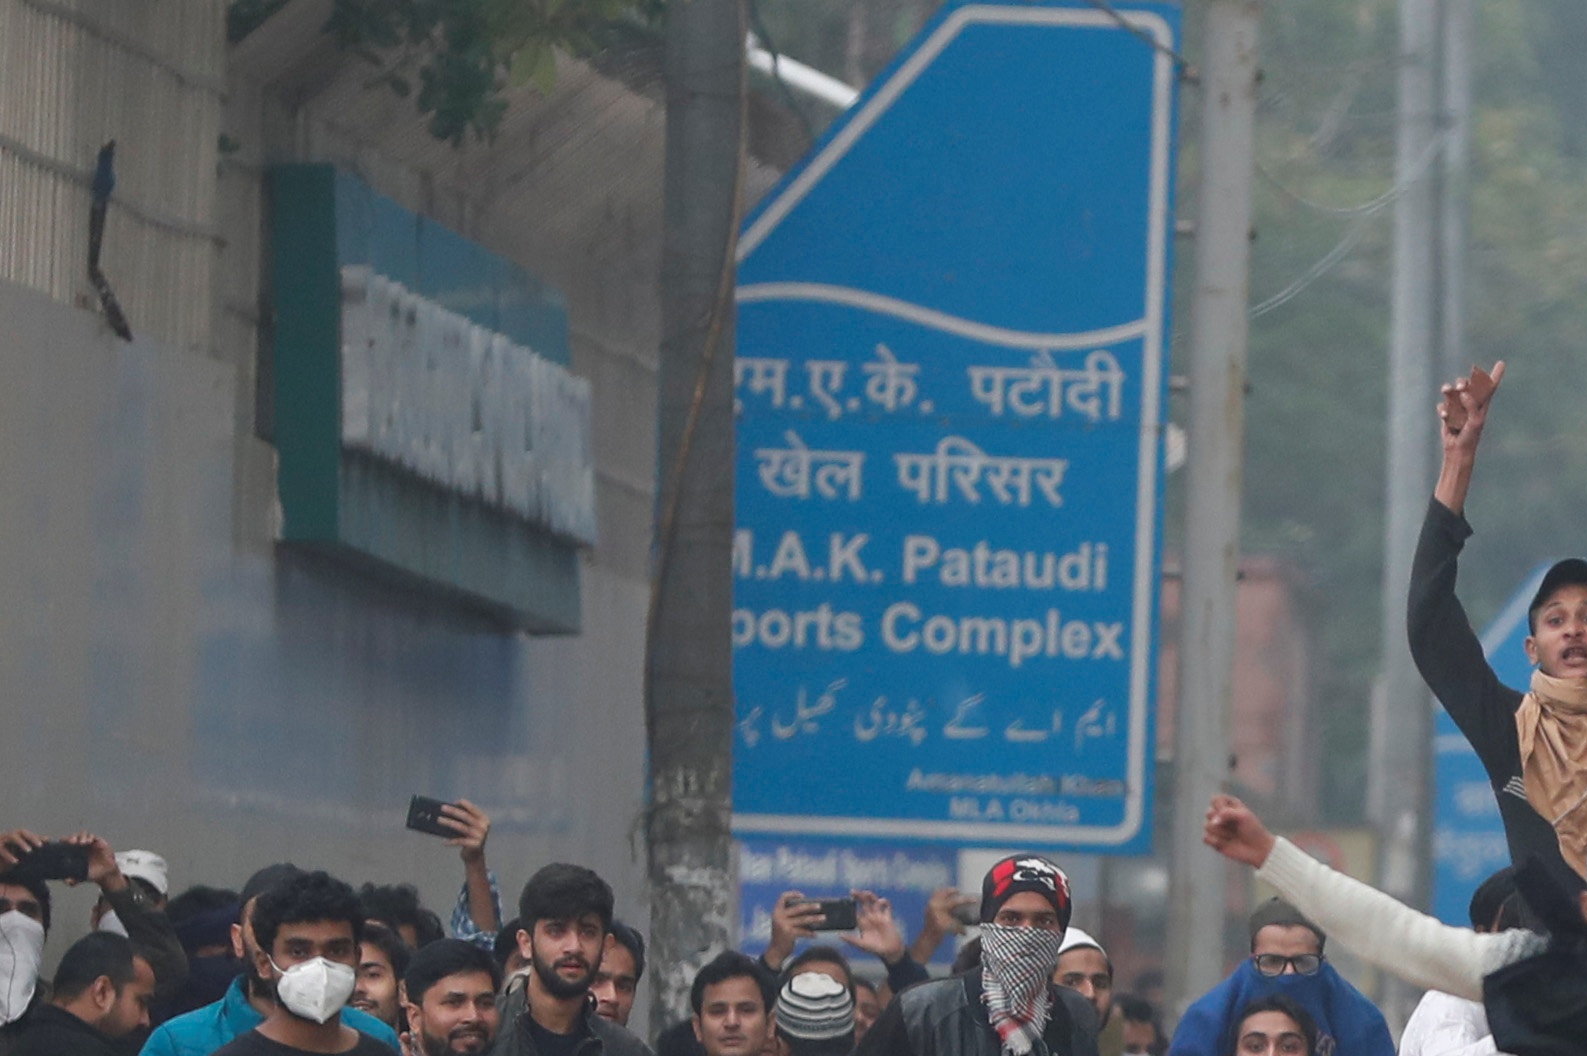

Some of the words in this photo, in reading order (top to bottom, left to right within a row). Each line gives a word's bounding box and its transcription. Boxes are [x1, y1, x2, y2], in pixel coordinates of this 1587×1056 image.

[756, 430, 865, 500] खेल
[895, 436, 1069, 507] परिसर
[903, 534, 1109, 592] Pataudi
[732, 603, 864, 652] ports
[881, 601, 1124, 668] Complex
